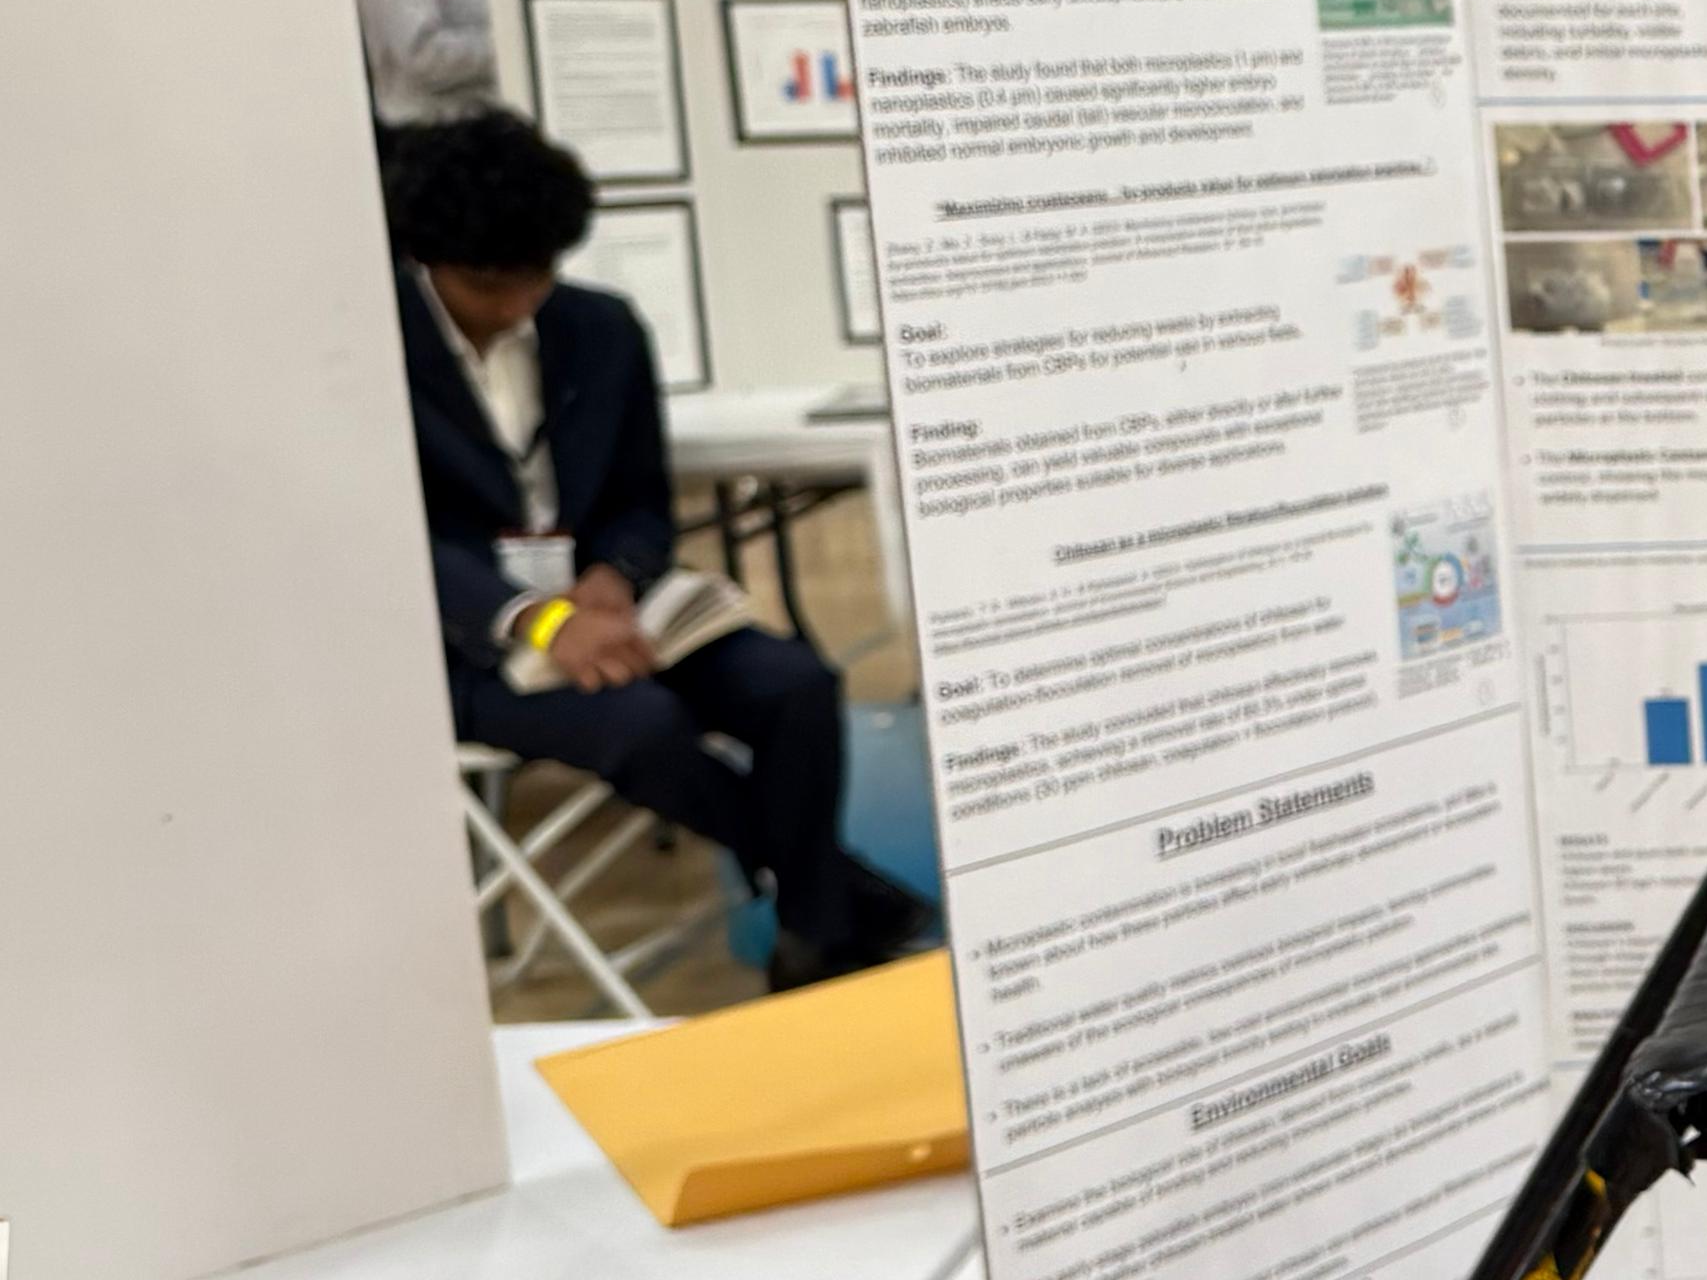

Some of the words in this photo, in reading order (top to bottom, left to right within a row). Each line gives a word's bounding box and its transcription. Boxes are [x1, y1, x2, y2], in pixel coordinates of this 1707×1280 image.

[1157, 808, 1252, 856] Problem
[1260, 772, 1375, 822] Statements
[1191, 1053, 1331, 1128] Environmental
[1337, 1032, 1391, 1073] Goals
